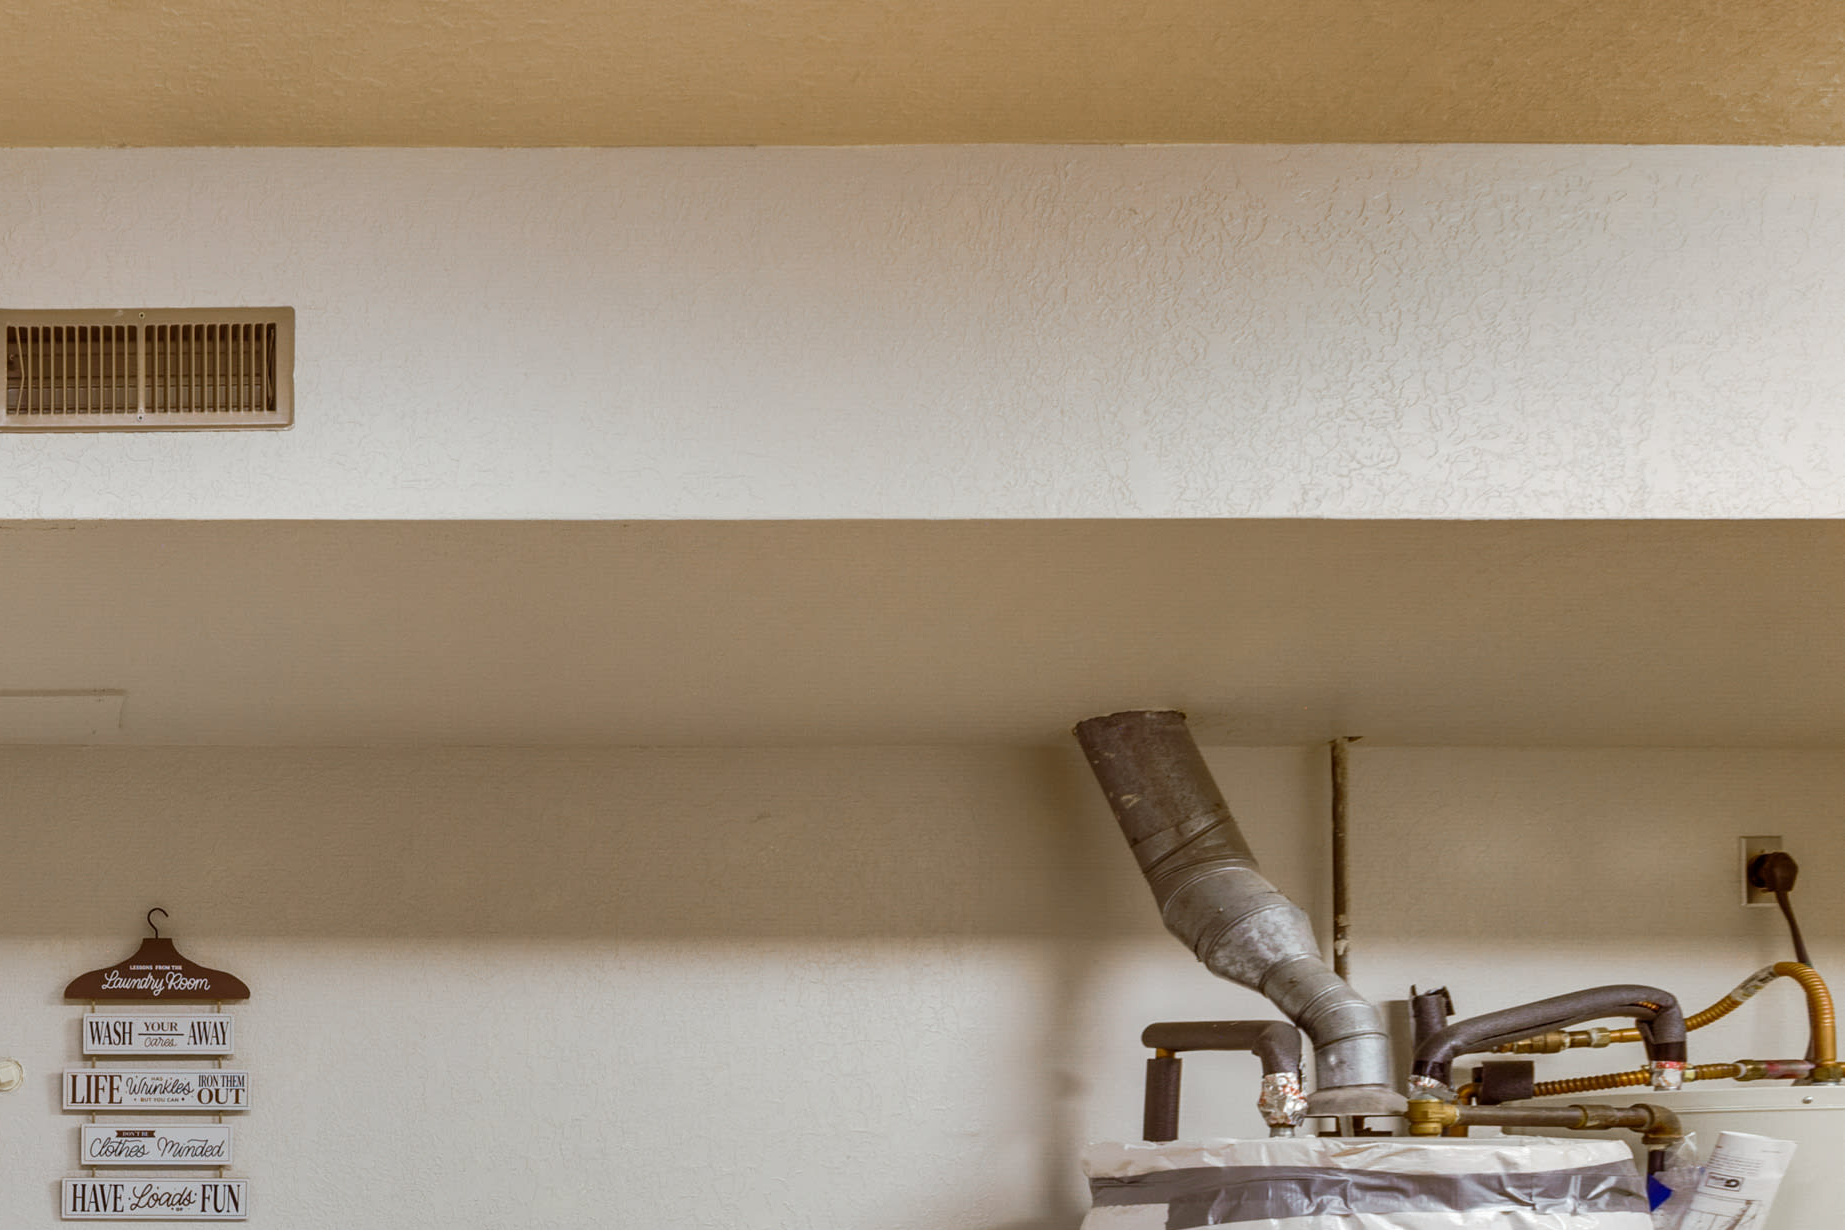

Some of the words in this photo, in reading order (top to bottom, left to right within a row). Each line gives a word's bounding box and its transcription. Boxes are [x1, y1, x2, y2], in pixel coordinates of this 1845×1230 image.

[101, 970, 165, 997] Laundry
[165, 971, 211, 991] Room
[89, 1021, 133, 1046] WASH
[143, 1021, 178, 1032] YOUR
[187, 1021, 229, 1046] AWAY
[70, 1074, 123, 1105] LIFE
[126, 1077, 195, 1096] Wrinkles
[197, 1088, 245, 1105] OUT
[198, 1075, 218, 1088] IRON
[220, 1075, 245, 1088] THEM
[90, 1137, 150, 1158] Clothes
[157, 1137, 225, 1158] Minded
[72, 1184, 124, 1212] HAVE
[130, 1184, 196, 1211] Loads
[201, 1184, 241, 1213] FUN
